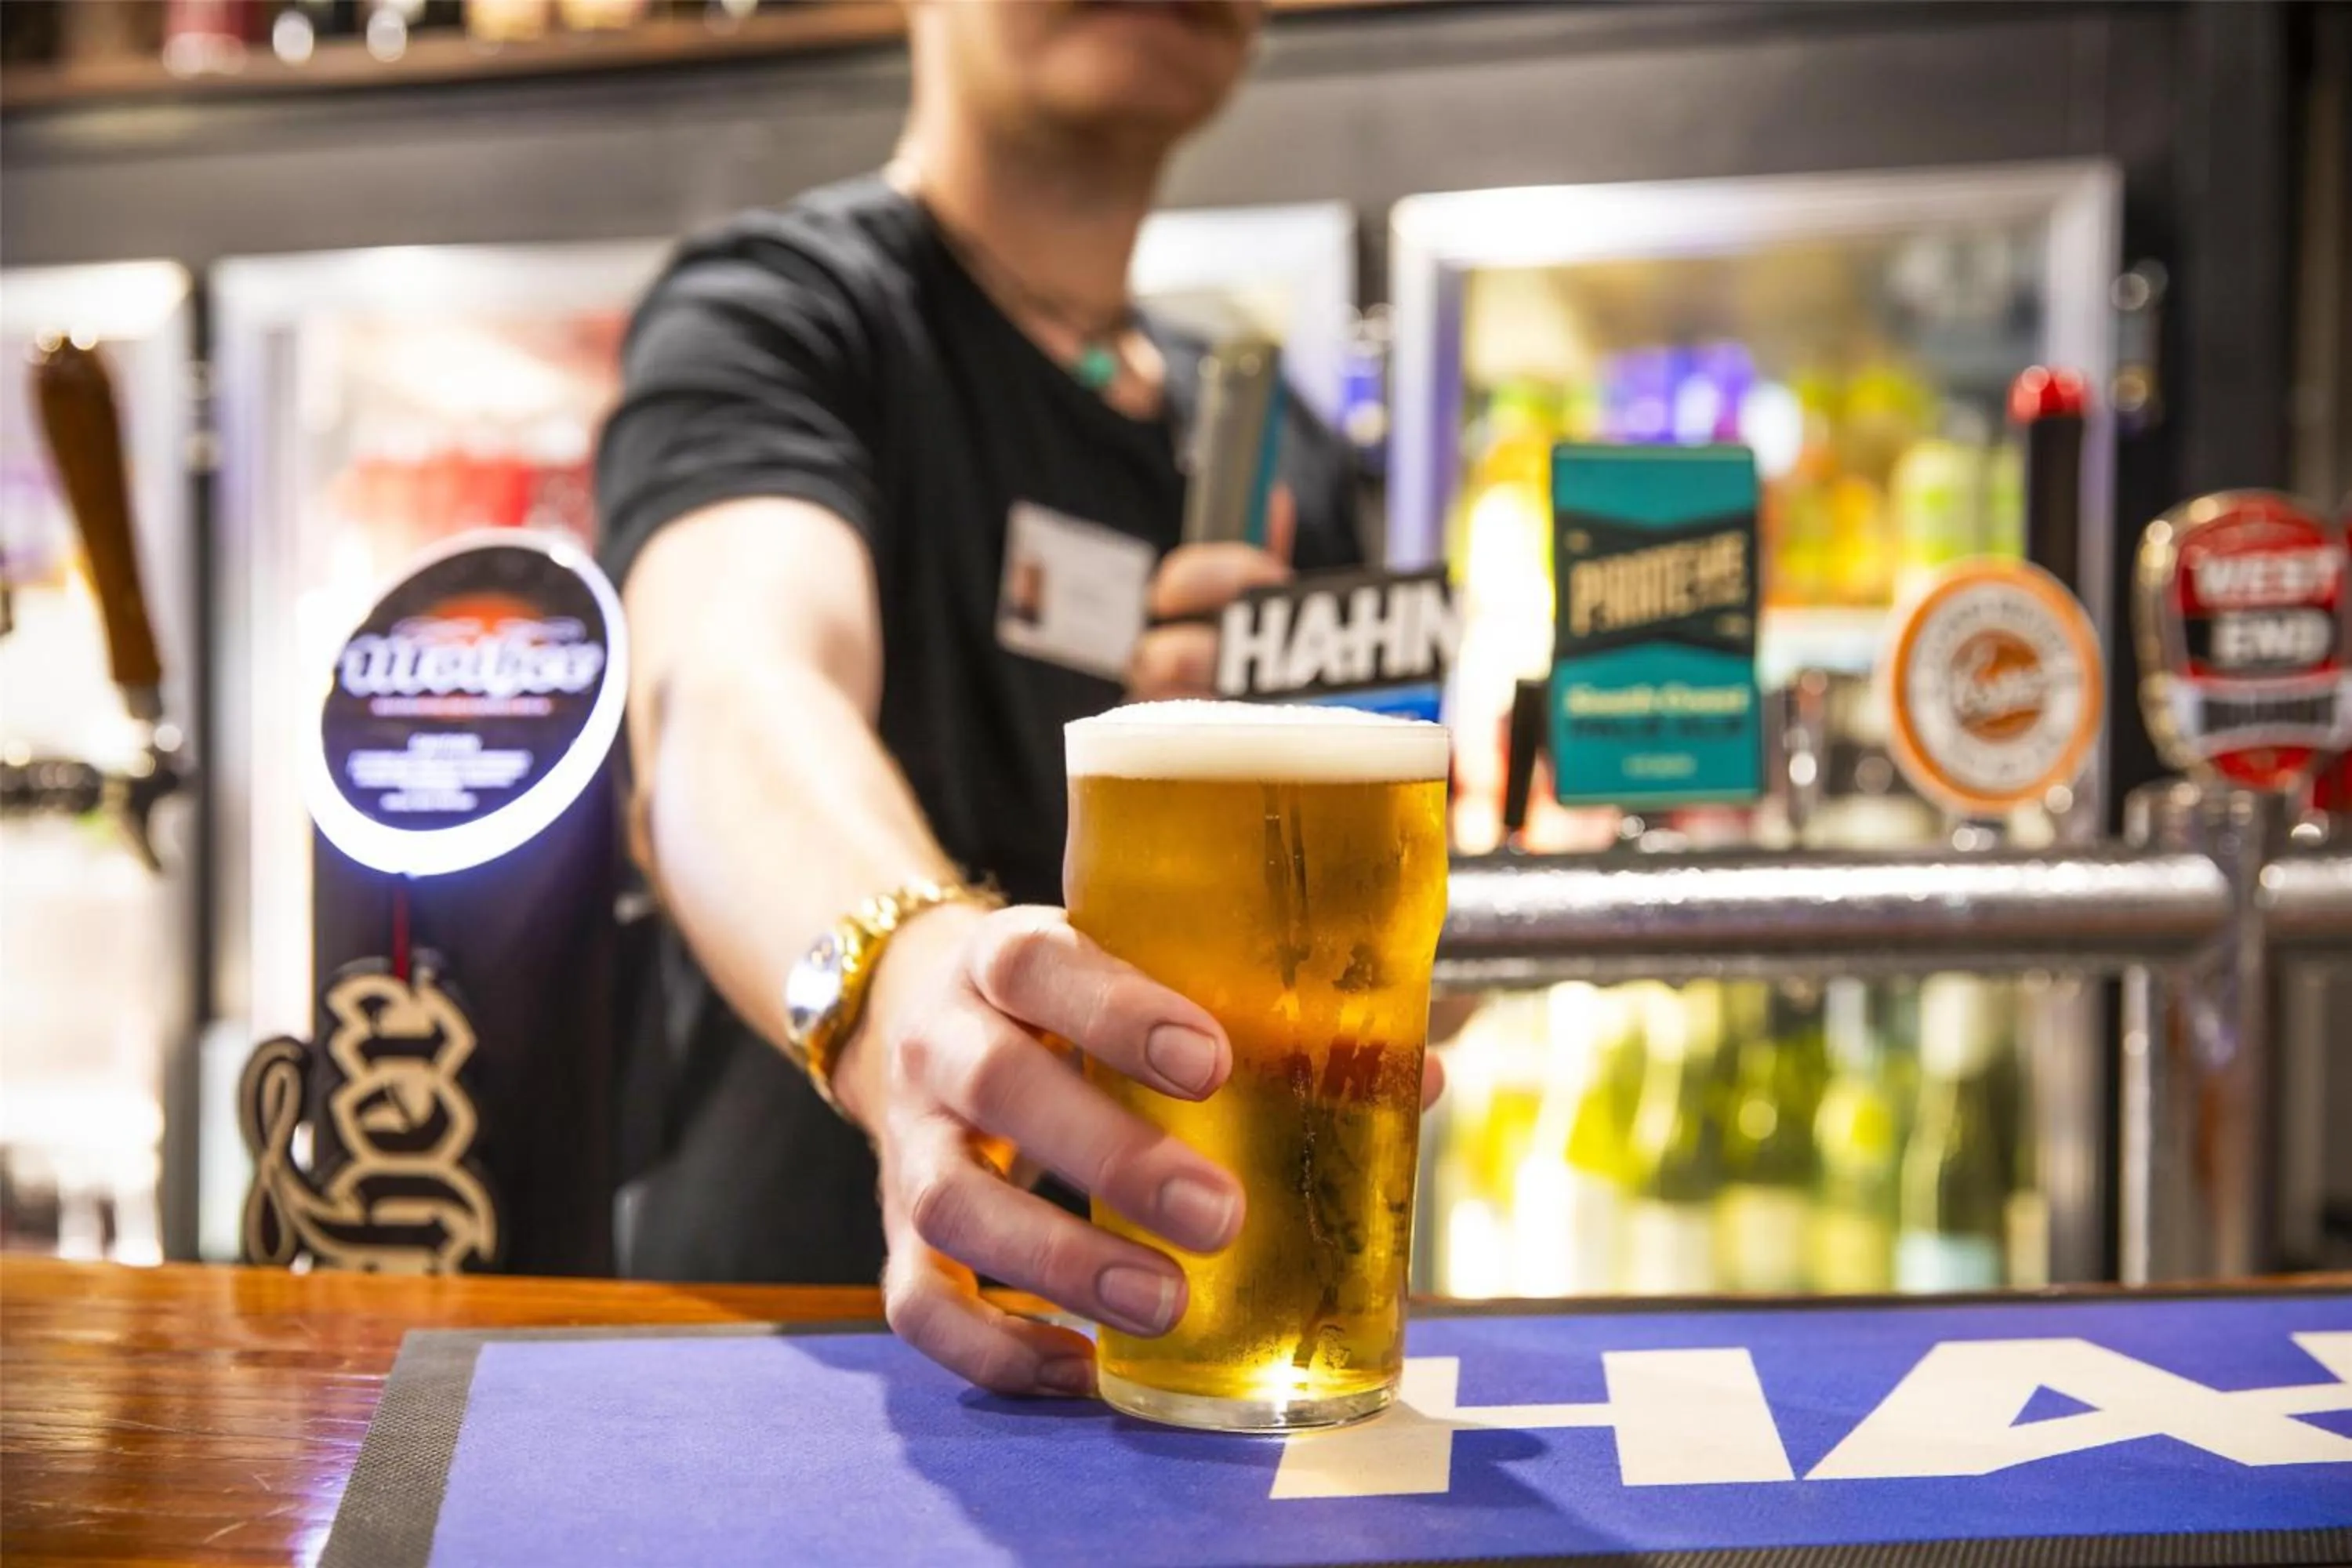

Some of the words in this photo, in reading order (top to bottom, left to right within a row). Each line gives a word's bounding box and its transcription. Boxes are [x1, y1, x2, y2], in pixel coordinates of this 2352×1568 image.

[2197, 546, 2346, 607] WEST
[1217, 578, 1465, 697] HAHN
[2213, 609, 2331, 664] END
